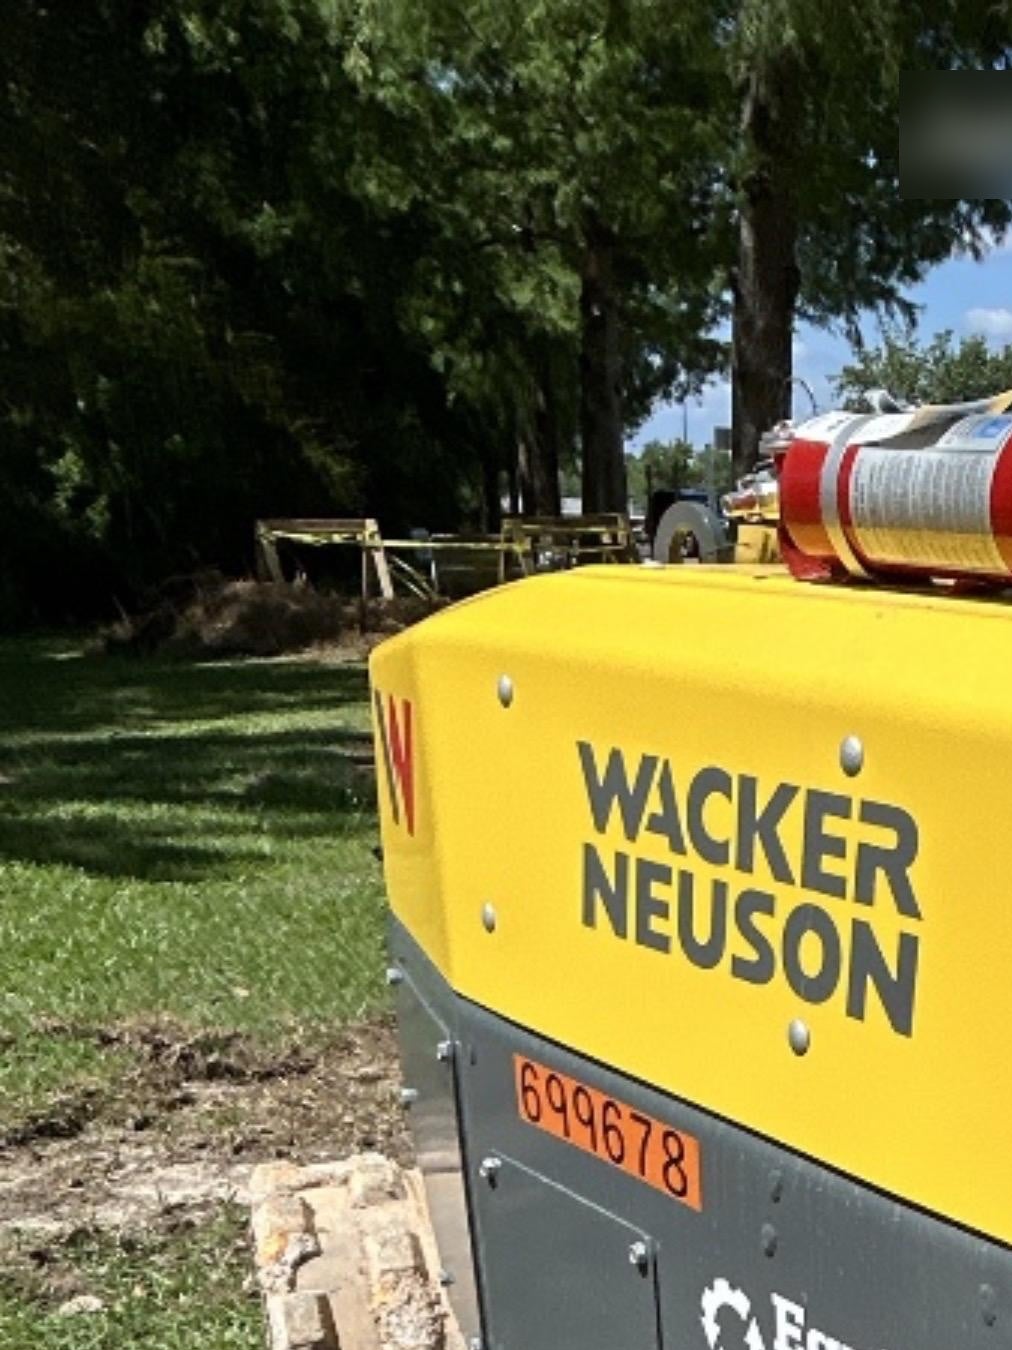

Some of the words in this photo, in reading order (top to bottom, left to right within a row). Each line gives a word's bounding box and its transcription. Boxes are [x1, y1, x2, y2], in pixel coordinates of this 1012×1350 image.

[576, 740, 923, 921] WACKER
[581, 842, 919, 1038] NEUSON
[520, 1061, 688, 1198] 699678
